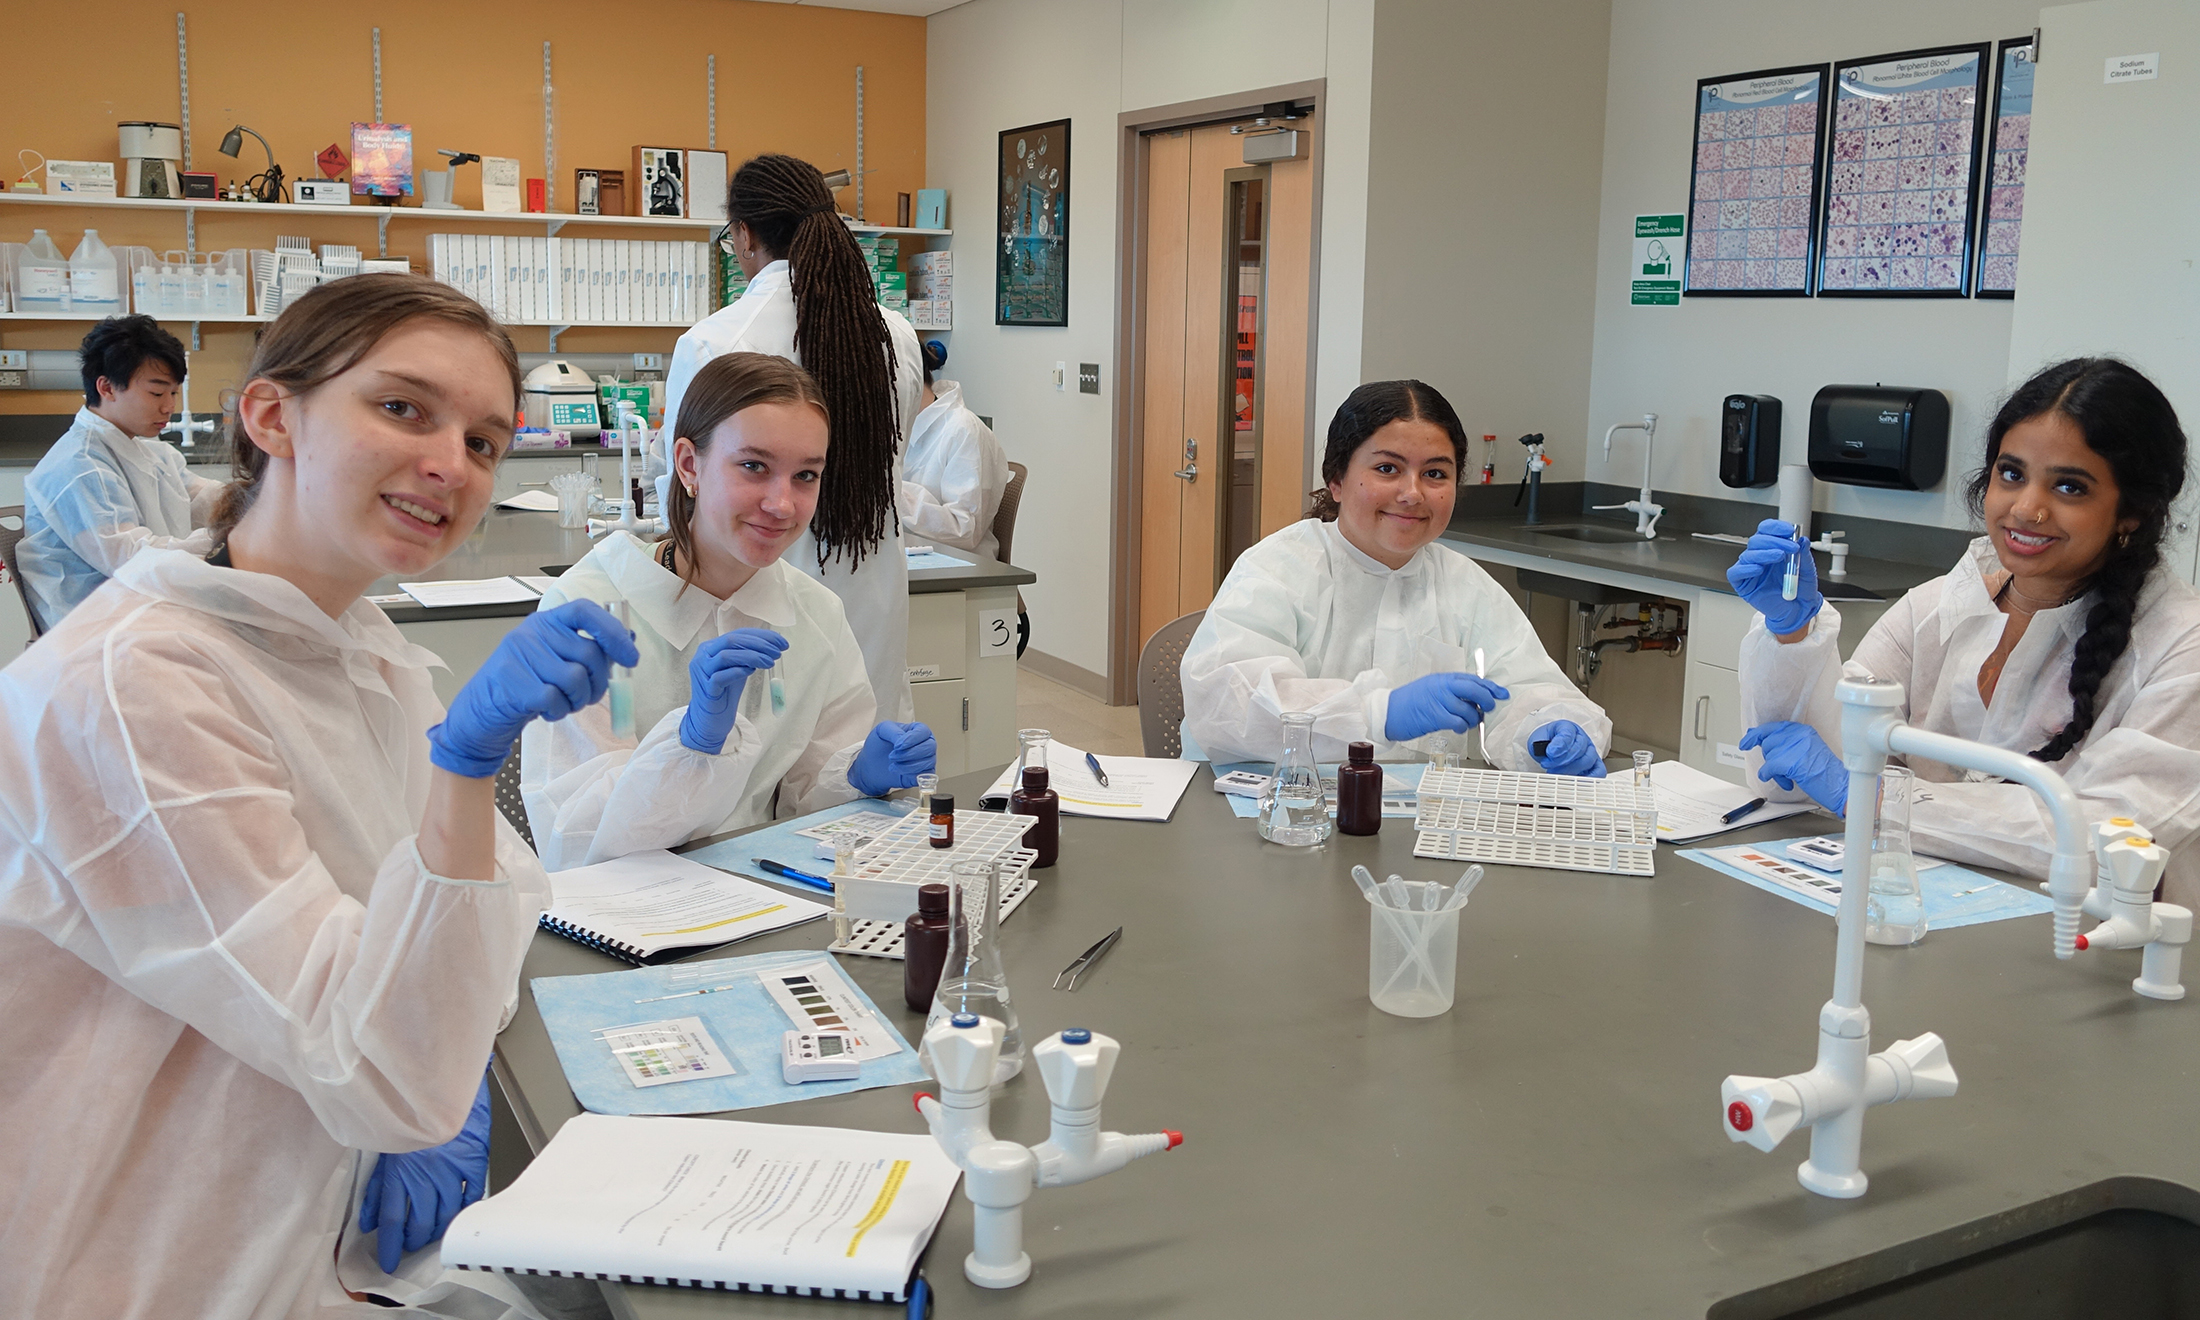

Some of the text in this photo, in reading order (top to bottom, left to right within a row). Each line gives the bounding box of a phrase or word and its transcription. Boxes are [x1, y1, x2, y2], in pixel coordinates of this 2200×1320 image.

[1896, 58, 1950, 71] Peripheral Blood
[2119, 60, 2145, 69] Sodium
[1872, 65, 1974, 82] Abnormal White Blood Cell Morphology
[2110, 68, 2153, 78] Citrate Tubes
[1750, 77, 1794, 89] Peripheral Blood
[1236, 349, 1255, 361] TROL
[1236, 367, 1252, 379] TION
[991, 619, 1010, 647] 3
[1722, 751, 1733, 759] Safety
